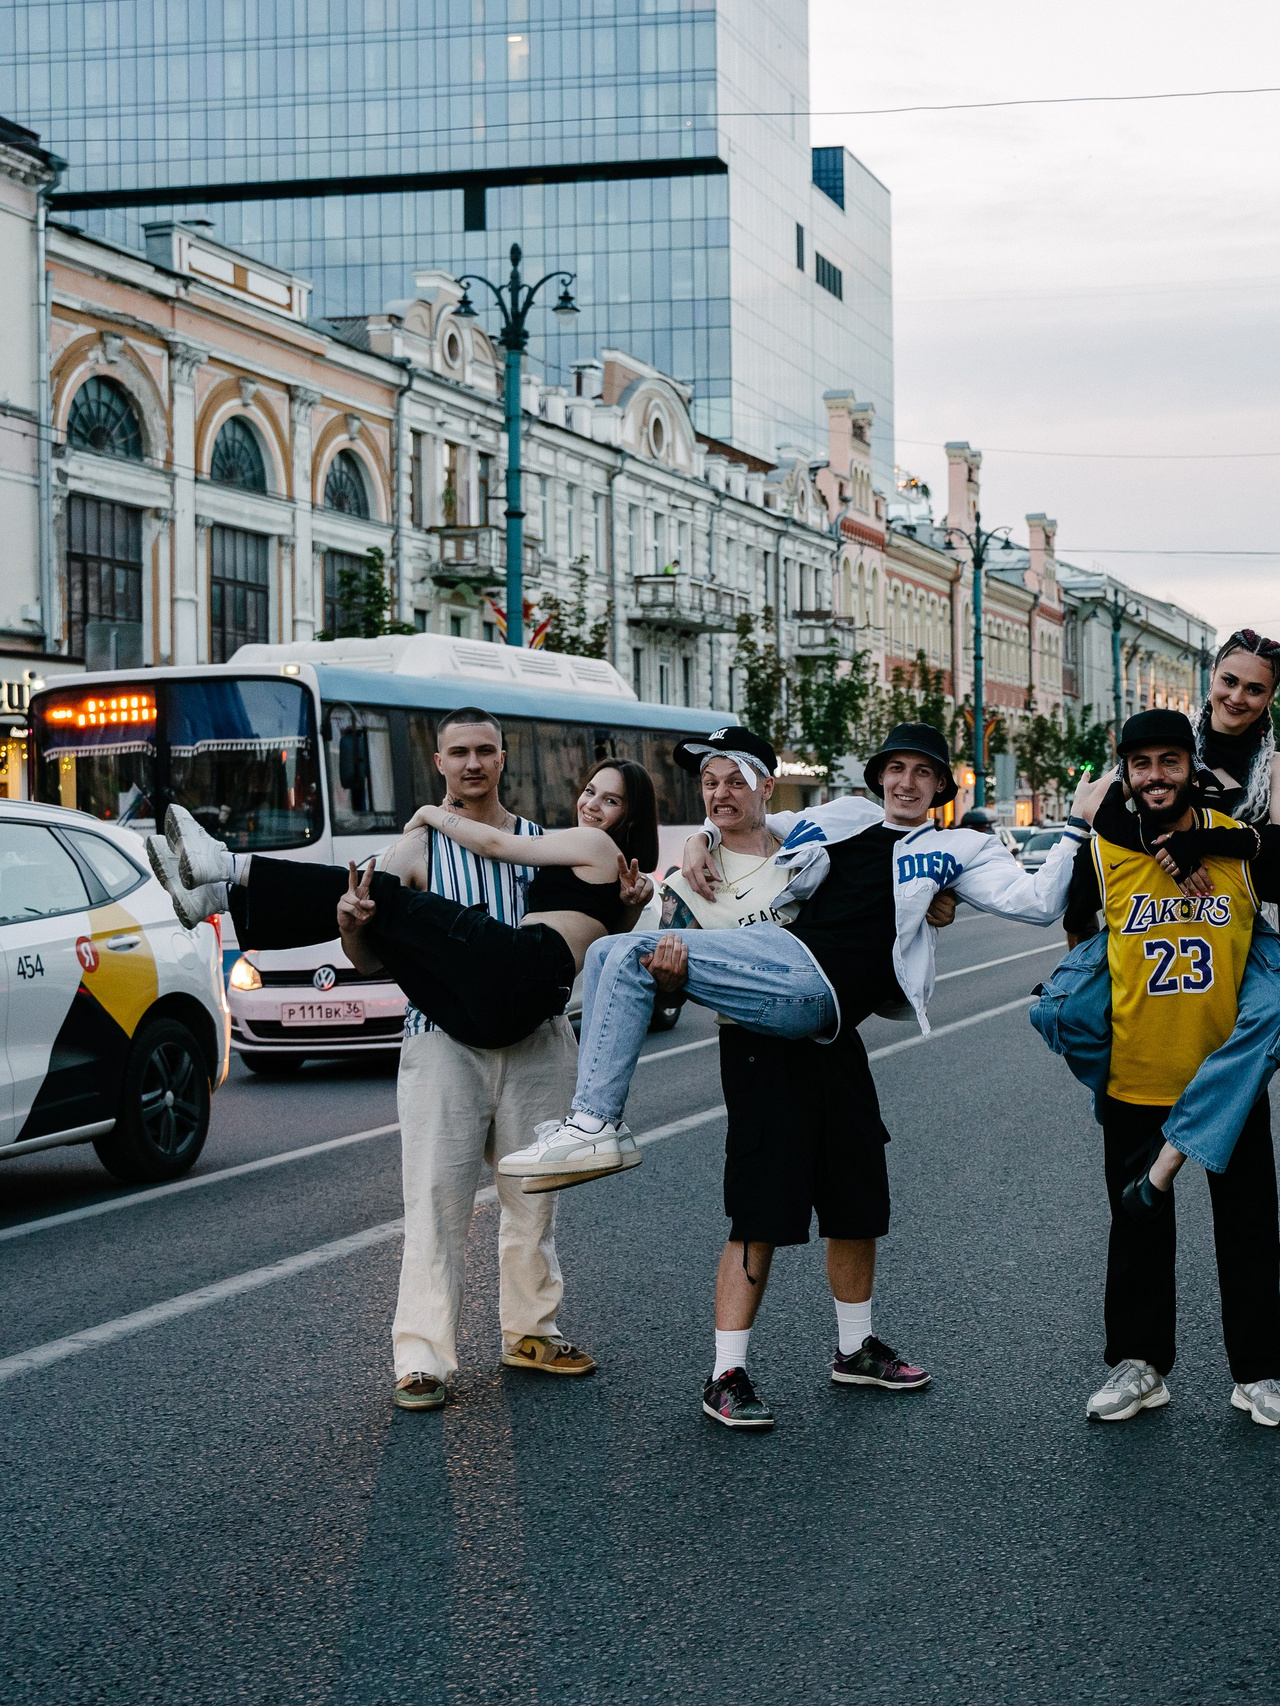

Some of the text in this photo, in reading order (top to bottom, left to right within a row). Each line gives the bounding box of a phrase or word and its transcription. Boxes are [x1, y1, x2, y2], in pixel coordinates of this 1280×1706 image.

[17, 954, 44, 979] 454
[1143, 937, 1214, 996] 23
[346, 1003, 360, 1013] 36
